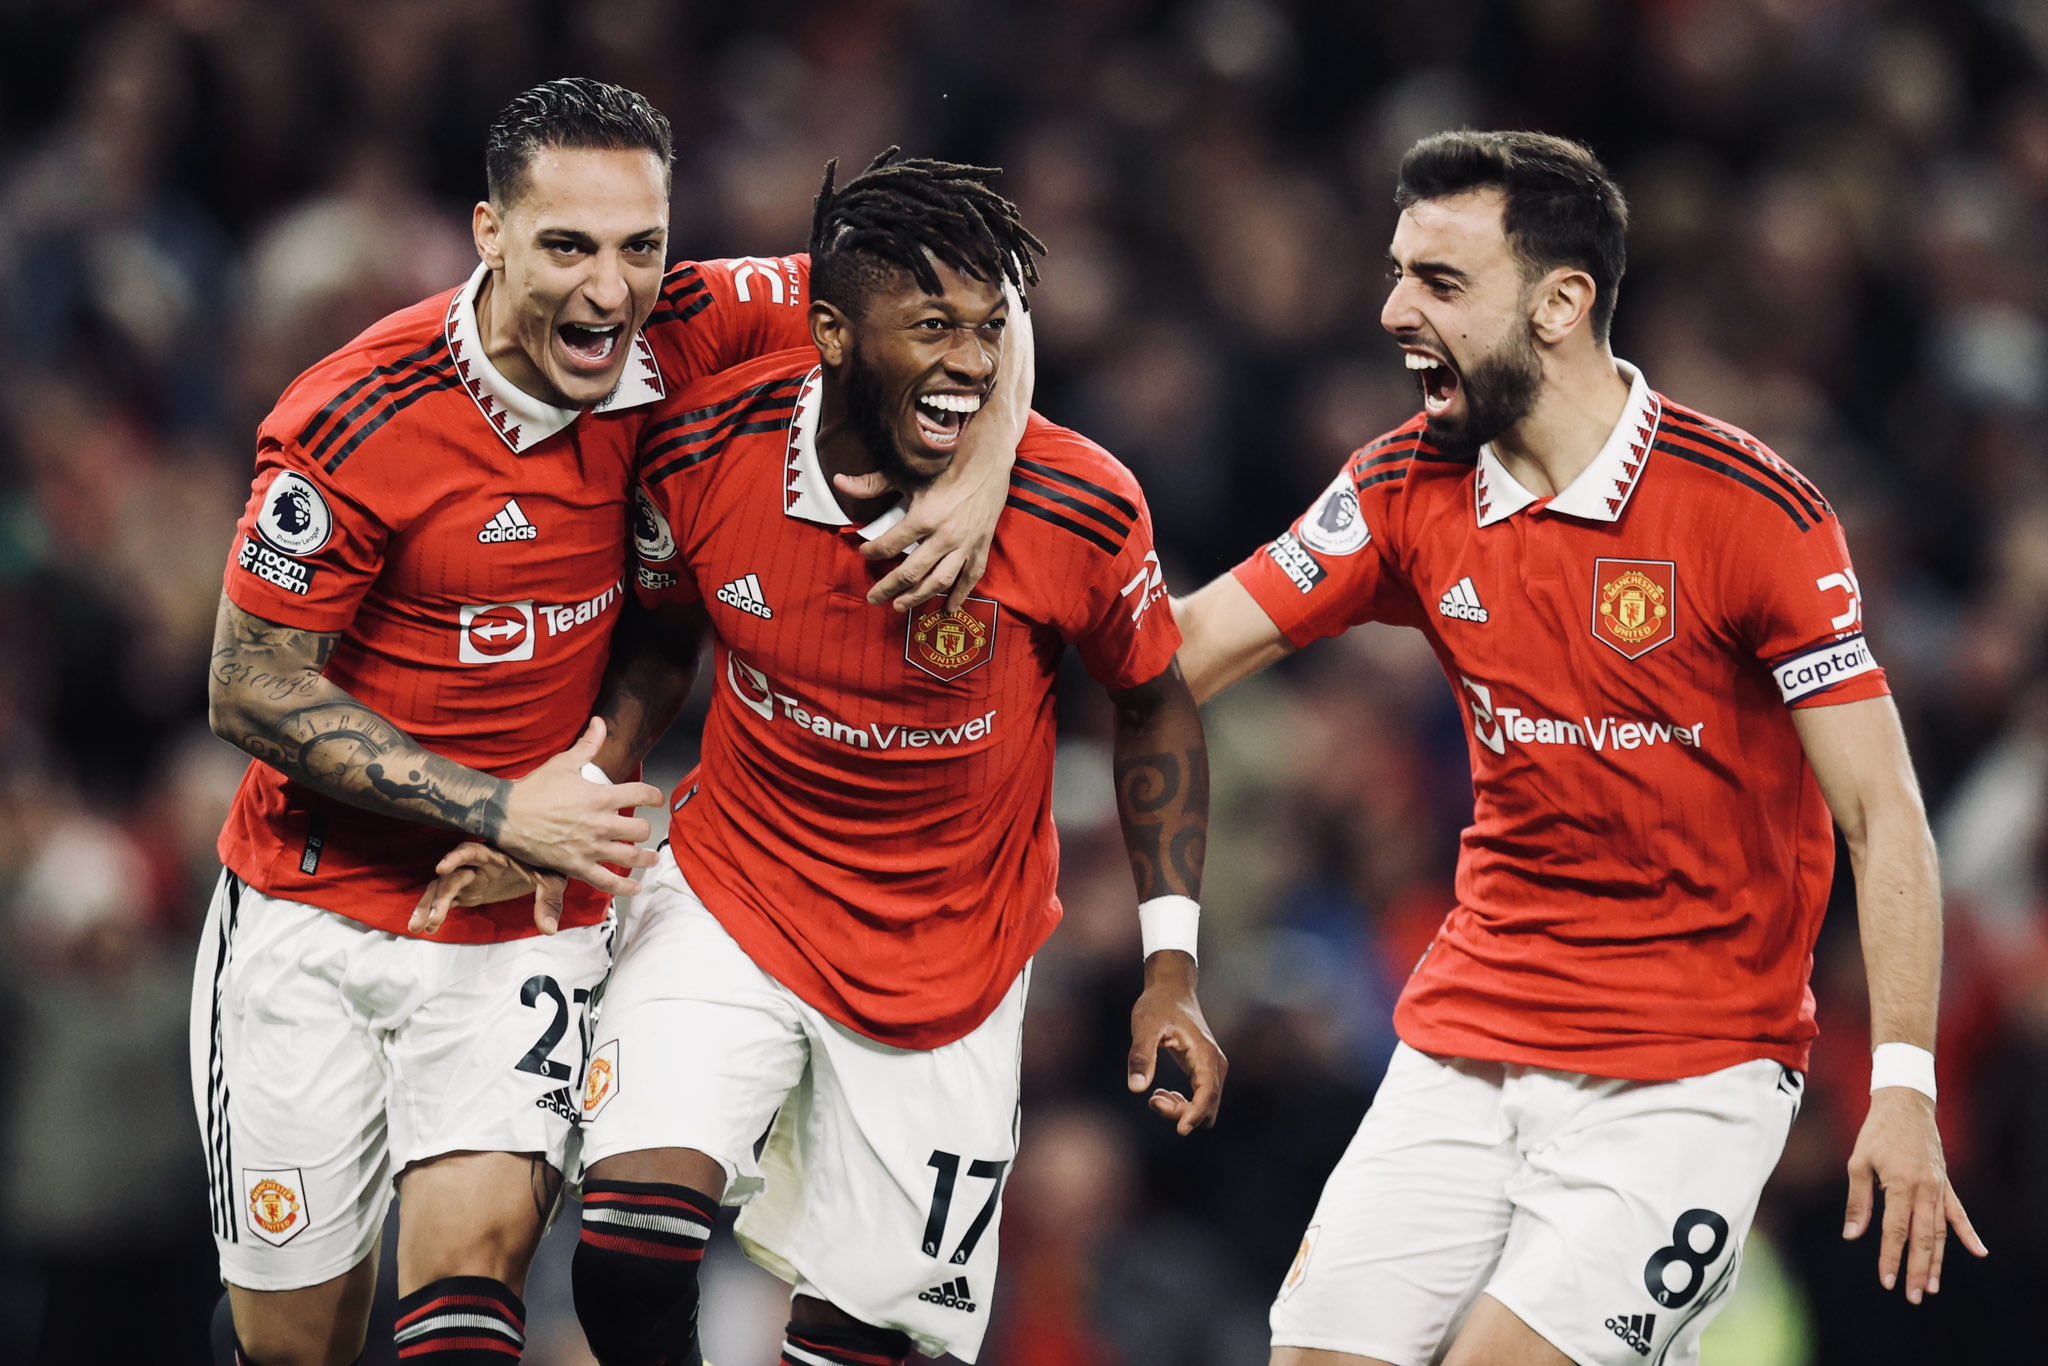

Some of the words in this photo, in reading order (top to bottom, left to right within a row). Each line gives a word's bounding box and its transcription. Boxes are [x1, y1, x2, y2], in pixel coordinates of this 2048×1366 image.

[276, 533, 302, 546] Premier
[302, 526, 320, 545] League
[479, 525, 537, 543] adidas
[258, 547, 306, 579] room
[252, 561, 308, 595] racism
[1607, 576, 1661, 601] MANCHESTER
[717, 588, 773, 619] adidas
[1439, 602, 1488, 623] adidas
[1613, 626, 1652, 638] UNITED
[929, 652, 970, 664] UNITED
[774, 691, 997, 750] TeamViewer
[1496, 707, 1704, 751] TeamViewer
[536, 1099, 580, 1126] adida
[921, 1149, 1010, 1265] 17
[261, 1219, 291, 1231] UNITED
[1644, 1208, 1729, 1310] 8
[918, 1291, 976, 1313] adidas
[1605, 1318, 1652, 1357] adidas
